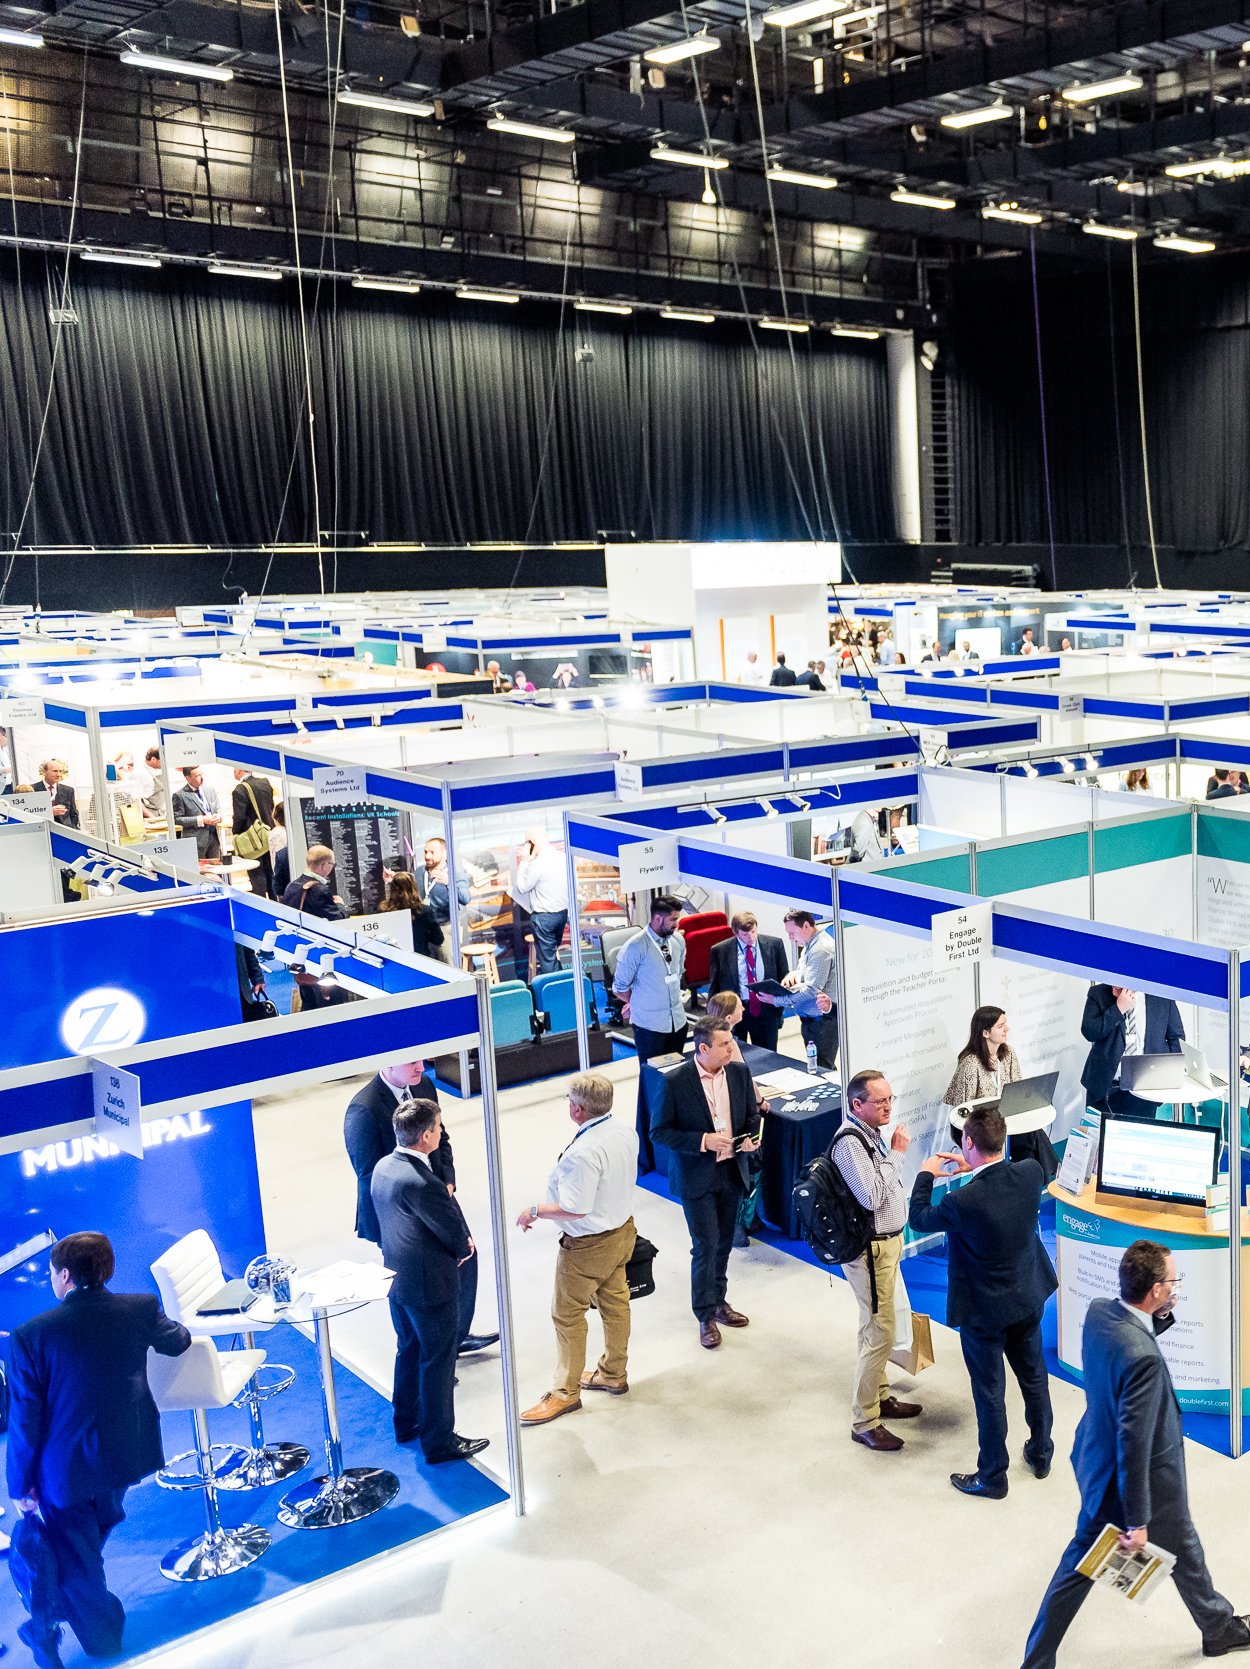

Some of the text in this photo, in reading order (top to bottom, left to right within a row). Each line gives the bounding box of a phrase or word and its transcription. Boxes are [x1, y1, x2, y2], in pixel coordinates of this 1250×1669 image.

[325, 778, 354, 786] Audience
[320, 786, 348, 794] Systems
[24, 806, 47, 814] Cutler
[153, 845, 169, 855] 135
[644, 846, 654, 854] 55
[639, 864, 664, 875] Flywire
[958, 915, 968, 924] 54
[361, 922, 380, 932] 136
[949, 926, 976, 940] Engage
[945, 936, 982, 952] by Double
[948, 948, 980, 961] First Ltd
[898, 974, 911, 984] and
[911, 969, 934, 982] budget
[862, 990, 888, 1004] through
[890, 986, 902, 996] the
[902, 980, 928, 993] Teacher
[110, 1076, 120, 1090] 136
[106, 1092, 126, 1110] Zurich
[102, 1106, 130, 1126] Municipal
[1062, 1214, 1088, 1234] engage
[1090, 1250, 1108, 1260] Mobile
[1097, 1260, 1107, 1268] and
[1106, 1278, 1116, 1287] and
[1180, 1320, 1204, 1328] reports
[1172, 1341, 1194, 1350] finance
[1180, 1358, 1204, 1368] reports
[1188, 1376, 1220, 1385] marketing
[1179, 1396, 1229, 1407] doublefirst.com
